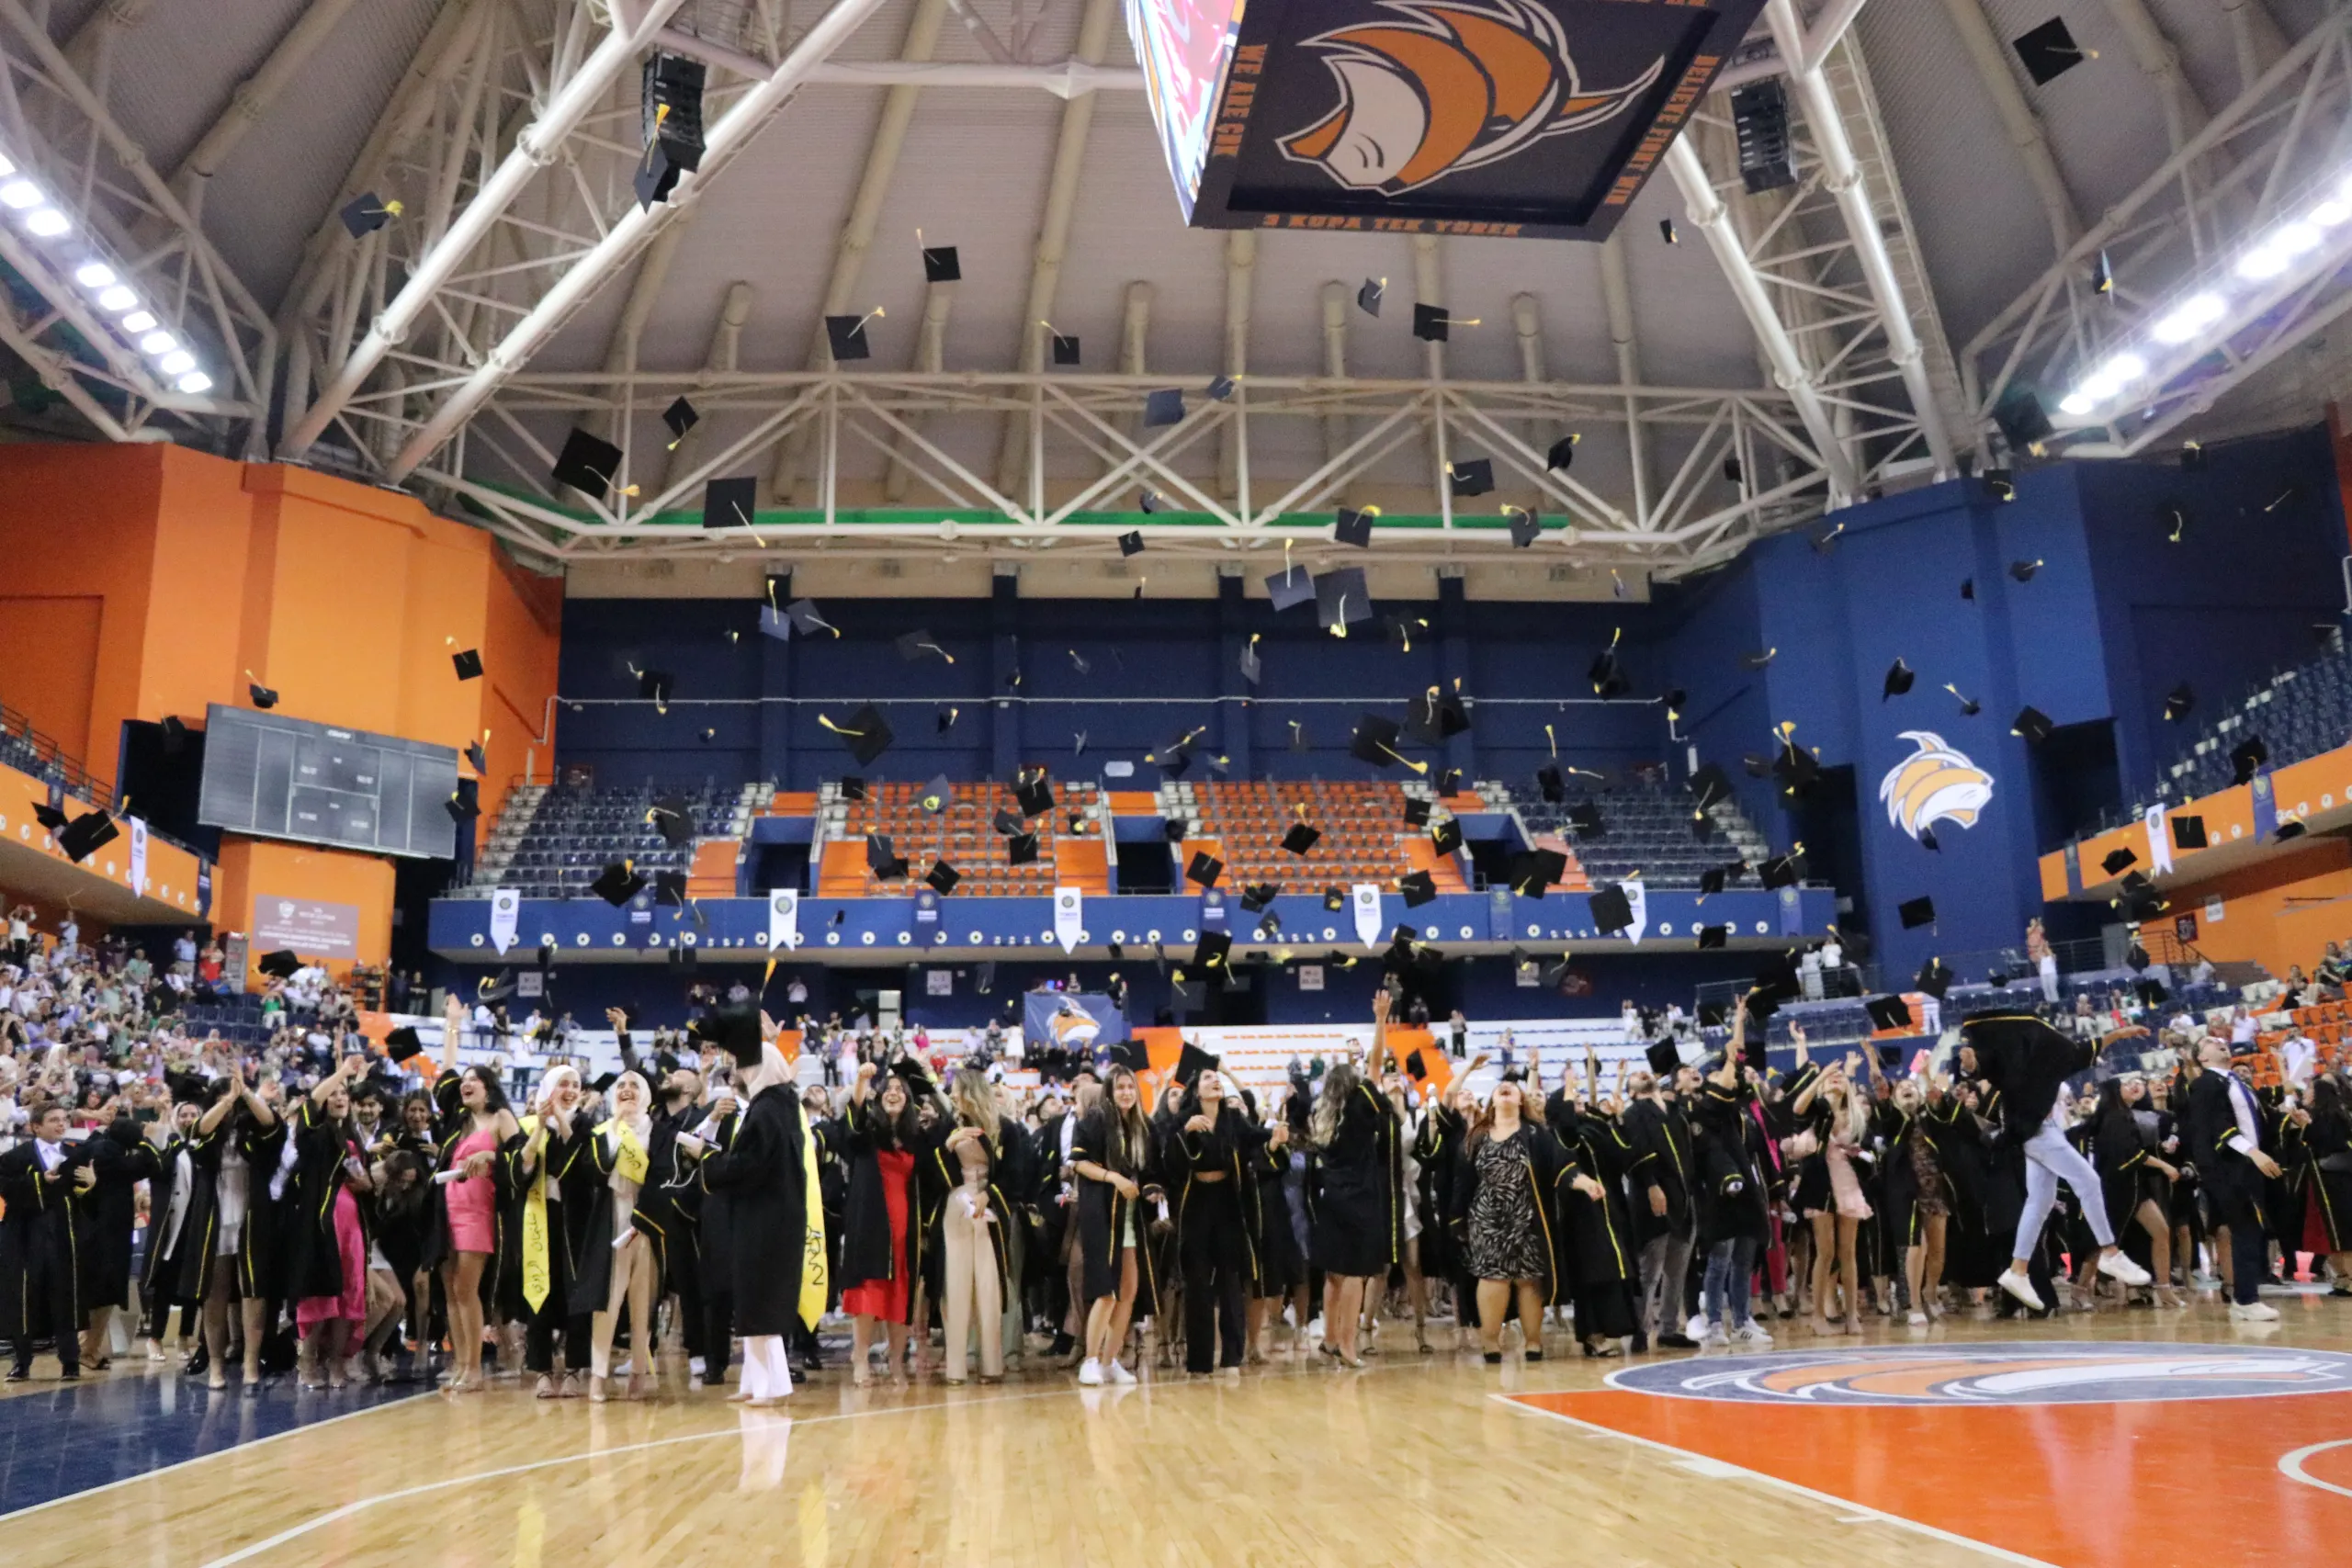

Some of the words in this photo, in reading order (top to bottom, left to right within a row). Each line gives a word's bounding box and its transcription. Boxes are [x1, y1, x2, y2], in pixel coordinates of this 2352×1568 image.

[1233, 44, 1268, 74] WE
[1222, 80, 1257, 118] ARE
[1374, 217, 1423, 231] TEK
